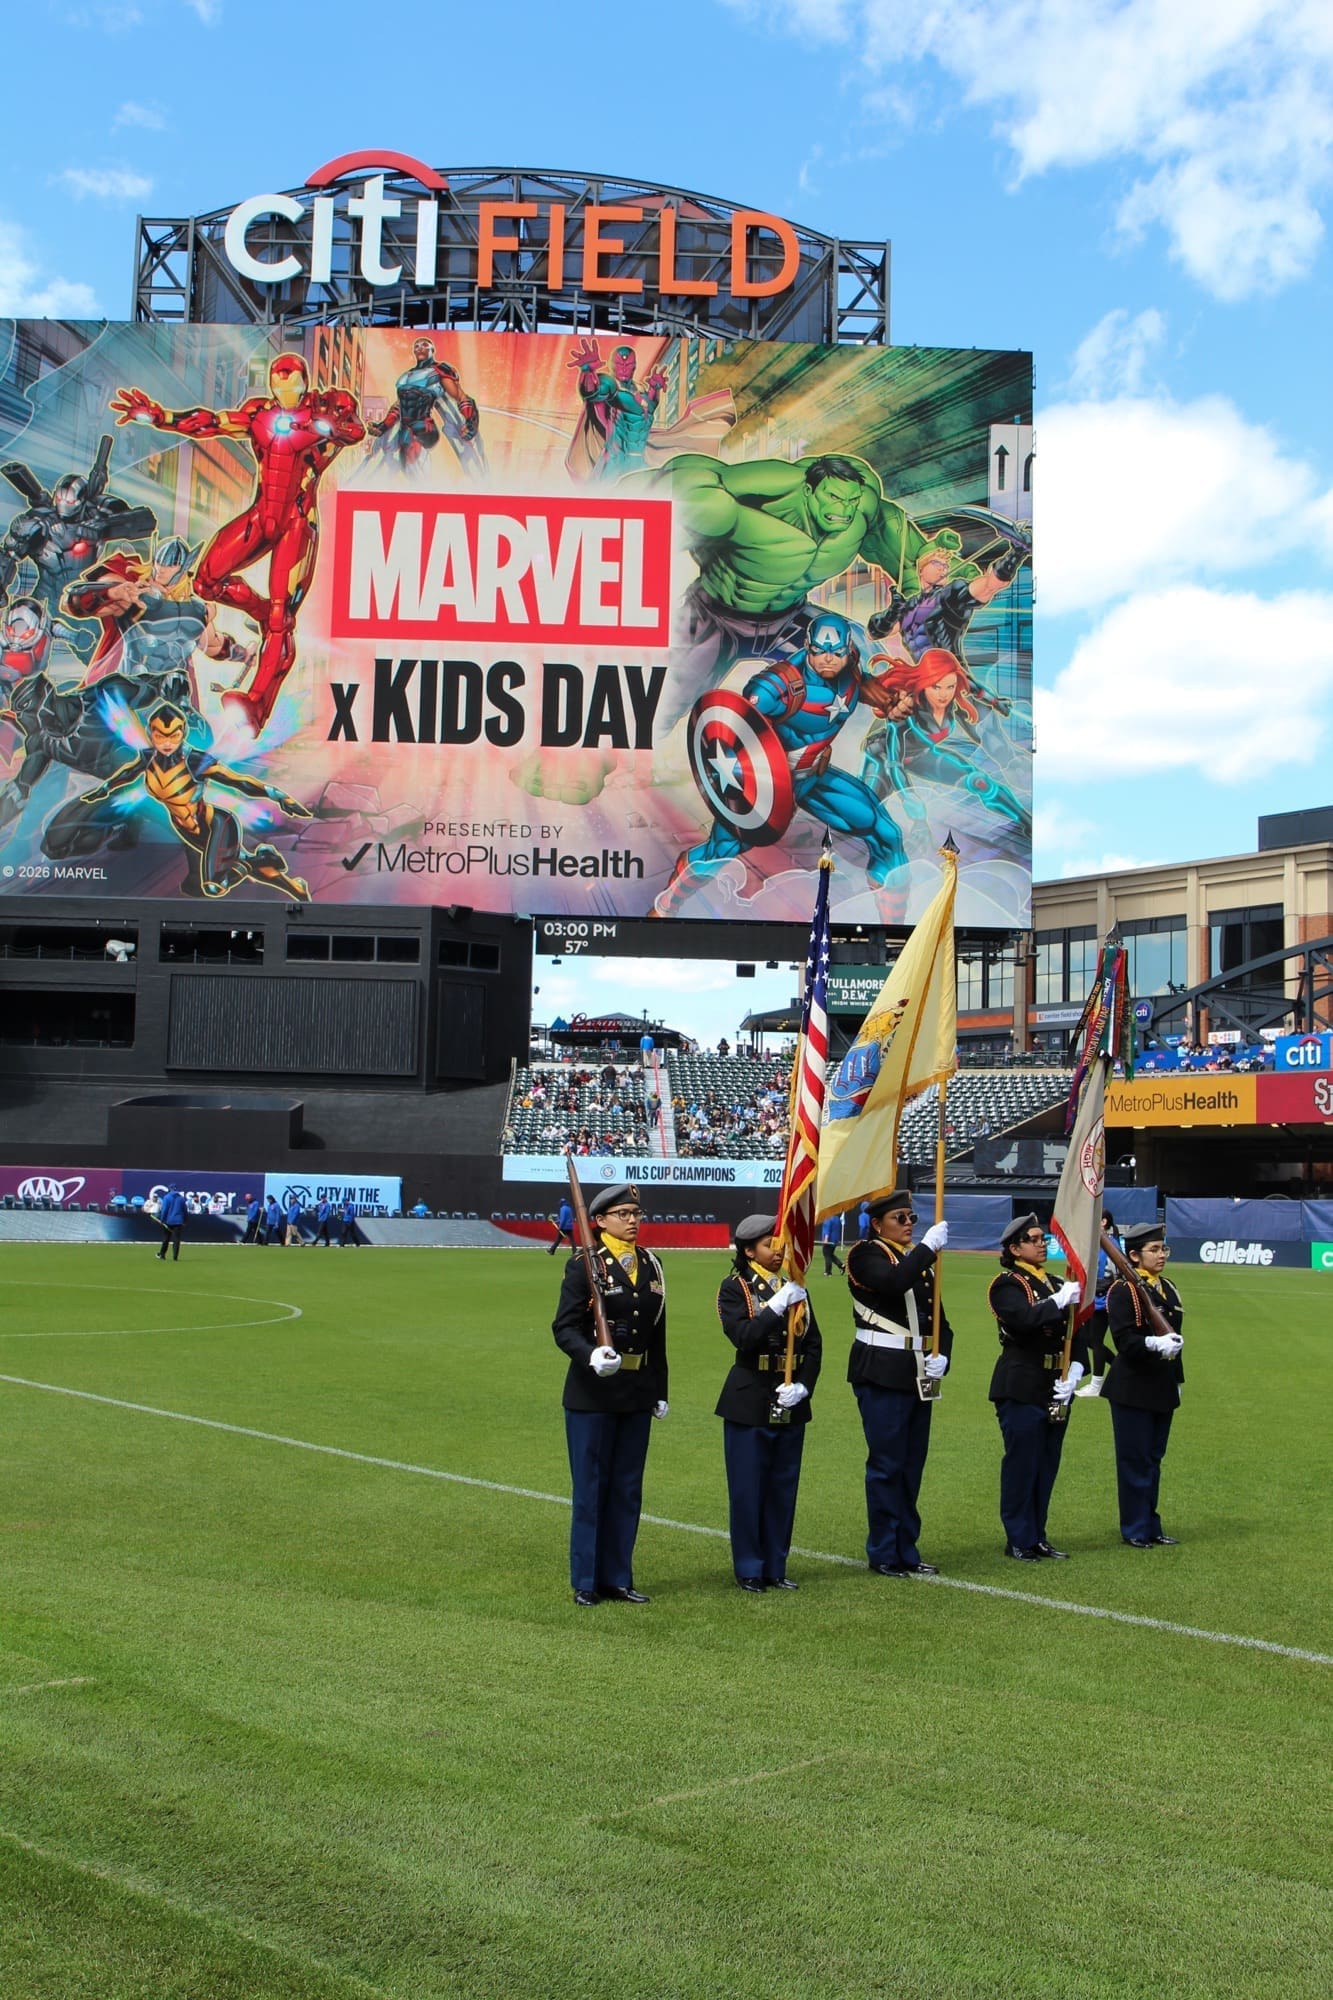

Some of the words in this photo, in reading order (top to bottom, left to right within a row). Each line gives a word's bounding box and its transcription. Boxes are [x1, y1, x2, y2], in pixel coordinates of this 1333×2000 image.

[224, 173, 439, 288] citi
[477, 201, 800, 298] FIELD
[348, 509, 660, 628] MARVEL
[372, 658, 526, 748] KIDS
[541, 663, 668, 751] DAY
[424, 822, 532, 838] PRESENTED
[541, 825, 564, 839] BY
[376, 842, 645, 879] MetroPlusHealth
[19, 865, 50, 878] 2026
[54, 867, 108, 880] MARVEL
[544, 922, 589, 937] 03:00
[593, 924, 617, 938] PM
[565, 940, 589, 954] 57°
[827, 978, 885, 990] TULLAMORE
[842, 989, 868, 1000] D.E.W.
[1285, 1041, 1321, 1066] citi
[1110, 1091, 1239, 1113] MetroPlusHealth
[1083, 1144, 1094, 1168] HIGH
[625, 1165, 649, 1180] MLS
[650, 1166, 671, 1181] CUP
[673, 1167, 736, 1182] CHAMPIONS
[149, 1185, 237, 1209] Csper
[316, 1186, 341, 1202] CITY
[344, 1187, 356, 1202] IN
[359, 1188, 380, 1203] THE
[1199, 1240, 1274, 1266] Gillette
